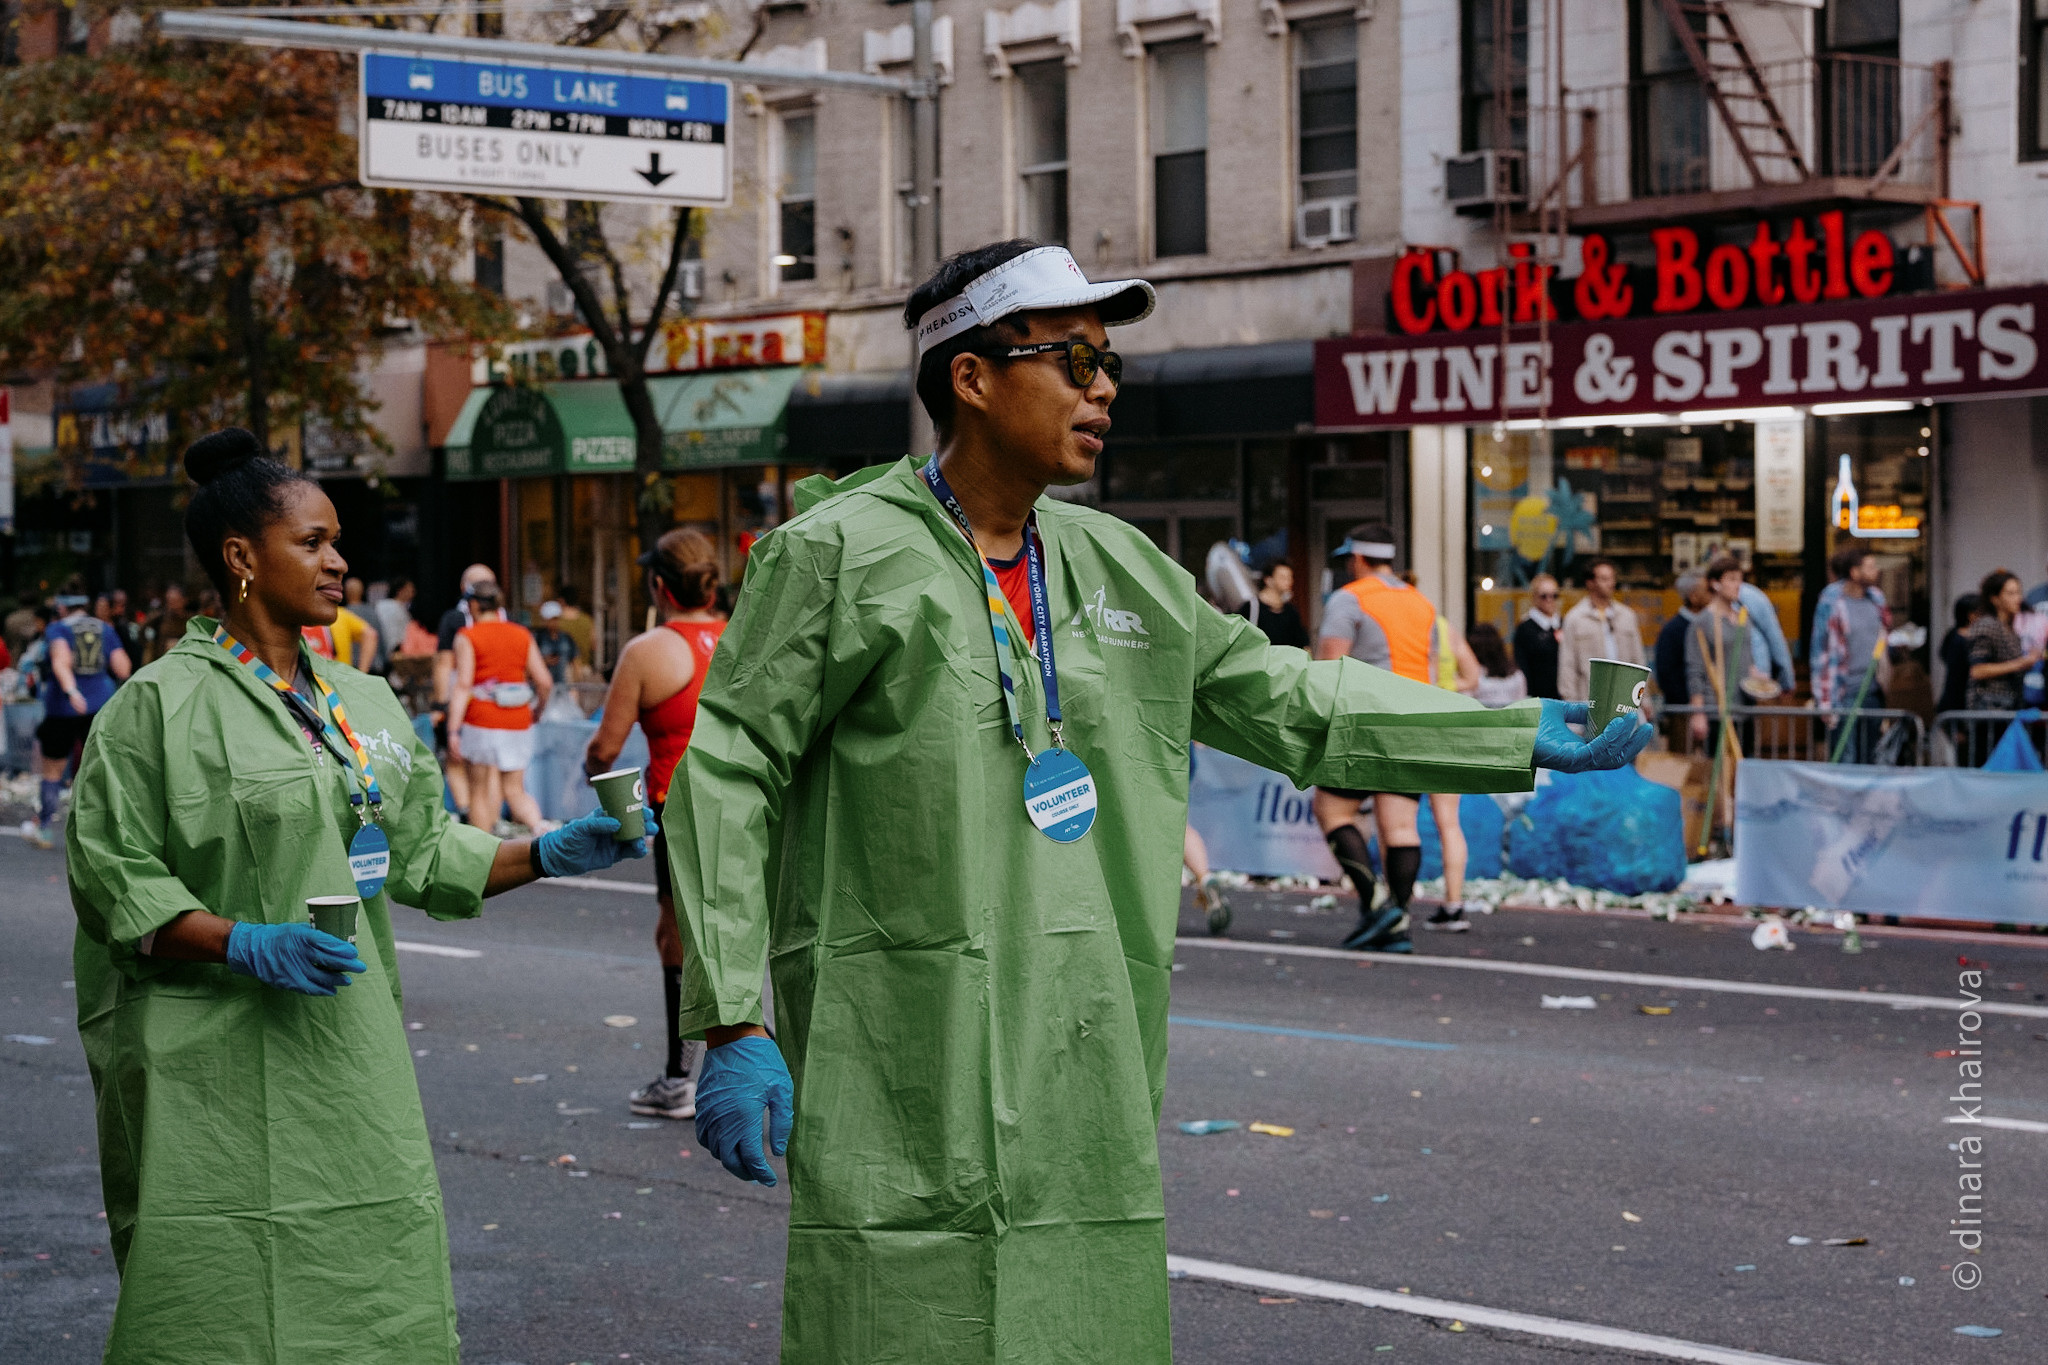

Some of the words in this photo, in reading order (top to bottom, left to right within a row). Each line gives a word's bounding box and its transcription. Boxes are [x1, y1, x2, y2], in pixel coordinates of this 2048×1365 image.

[478, 71, 529, 99] BUS
[554, 78, 619, 108] LANE
[417, 133, 502, 163] BUSES
[517, 139, 587, 168] ONLY
[1391, 242, 1558, 335] Cork
[1574, 233, 1634, 320] &
[1651, 209, 1894, 313] Bottle
[1342, 342, 1554, 415] WINE
[1573, 333, 1638, 404] &
[1652, 303, 2039, 403] SPIRITS
[929, 468, 940, 486] TCS
[1031, 563, 1039, 581] NEW
[1033, 580, 1043, 605] YORK
[1036, 605, 1046, 626] CITY
[1039, 627, 1052, 677] MARATHON
[1109, 637, 1150, 650] RUNNERS
[1032, 784, 1090, 814] VOLUNTEER
[352, 857, 387, 868] VOLUNTEER
